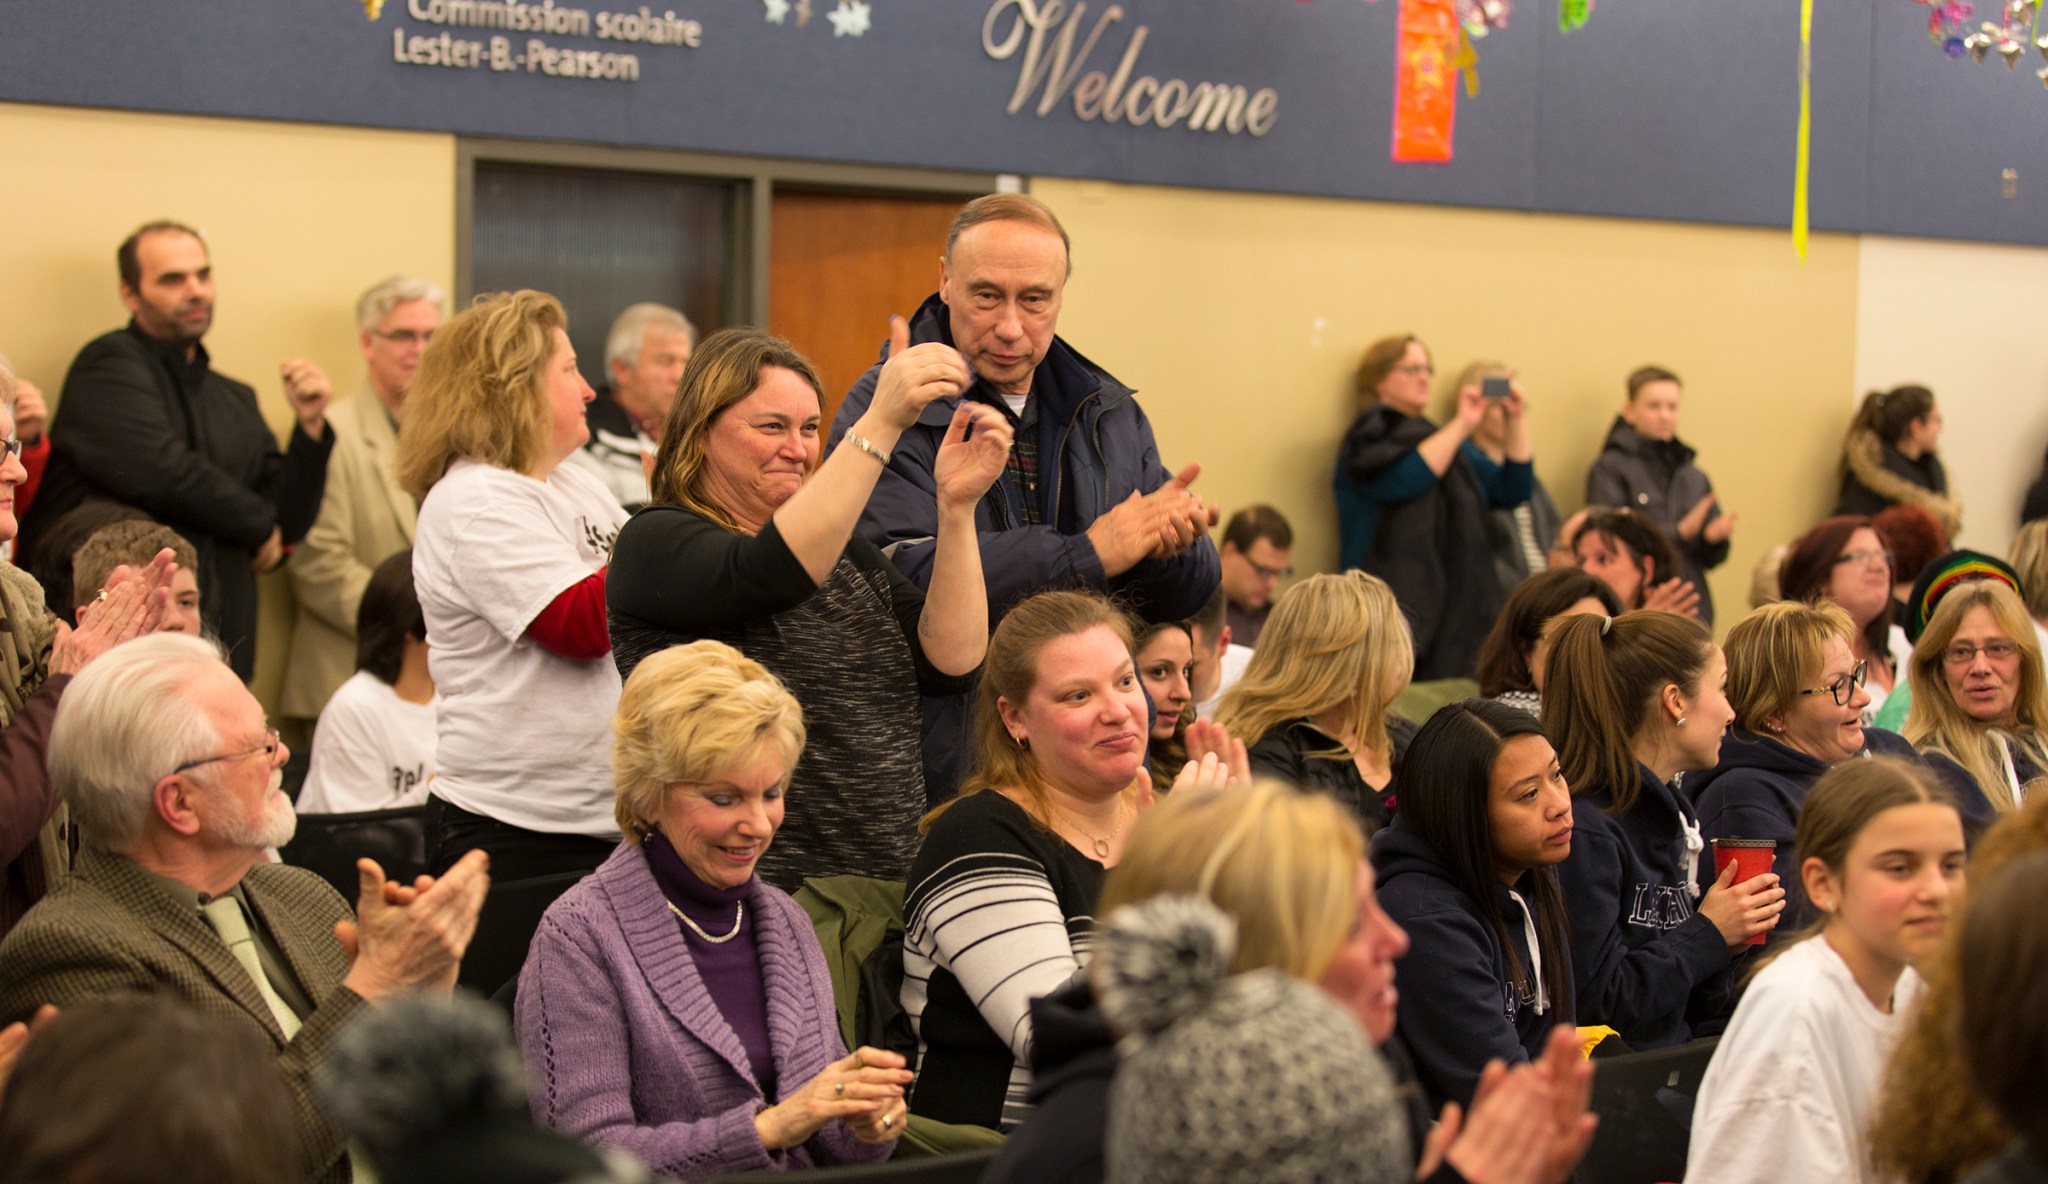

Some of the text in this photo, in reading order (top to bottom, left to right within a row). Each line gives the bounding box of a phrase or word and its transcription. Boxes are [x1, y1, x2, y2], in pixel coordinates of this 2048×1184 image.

[408, 0, 702, 48] Commission scolaire
[394, 26, 641, 82] Lester-B.-Pearson
[981, 0, 1279, 137] Welcome
